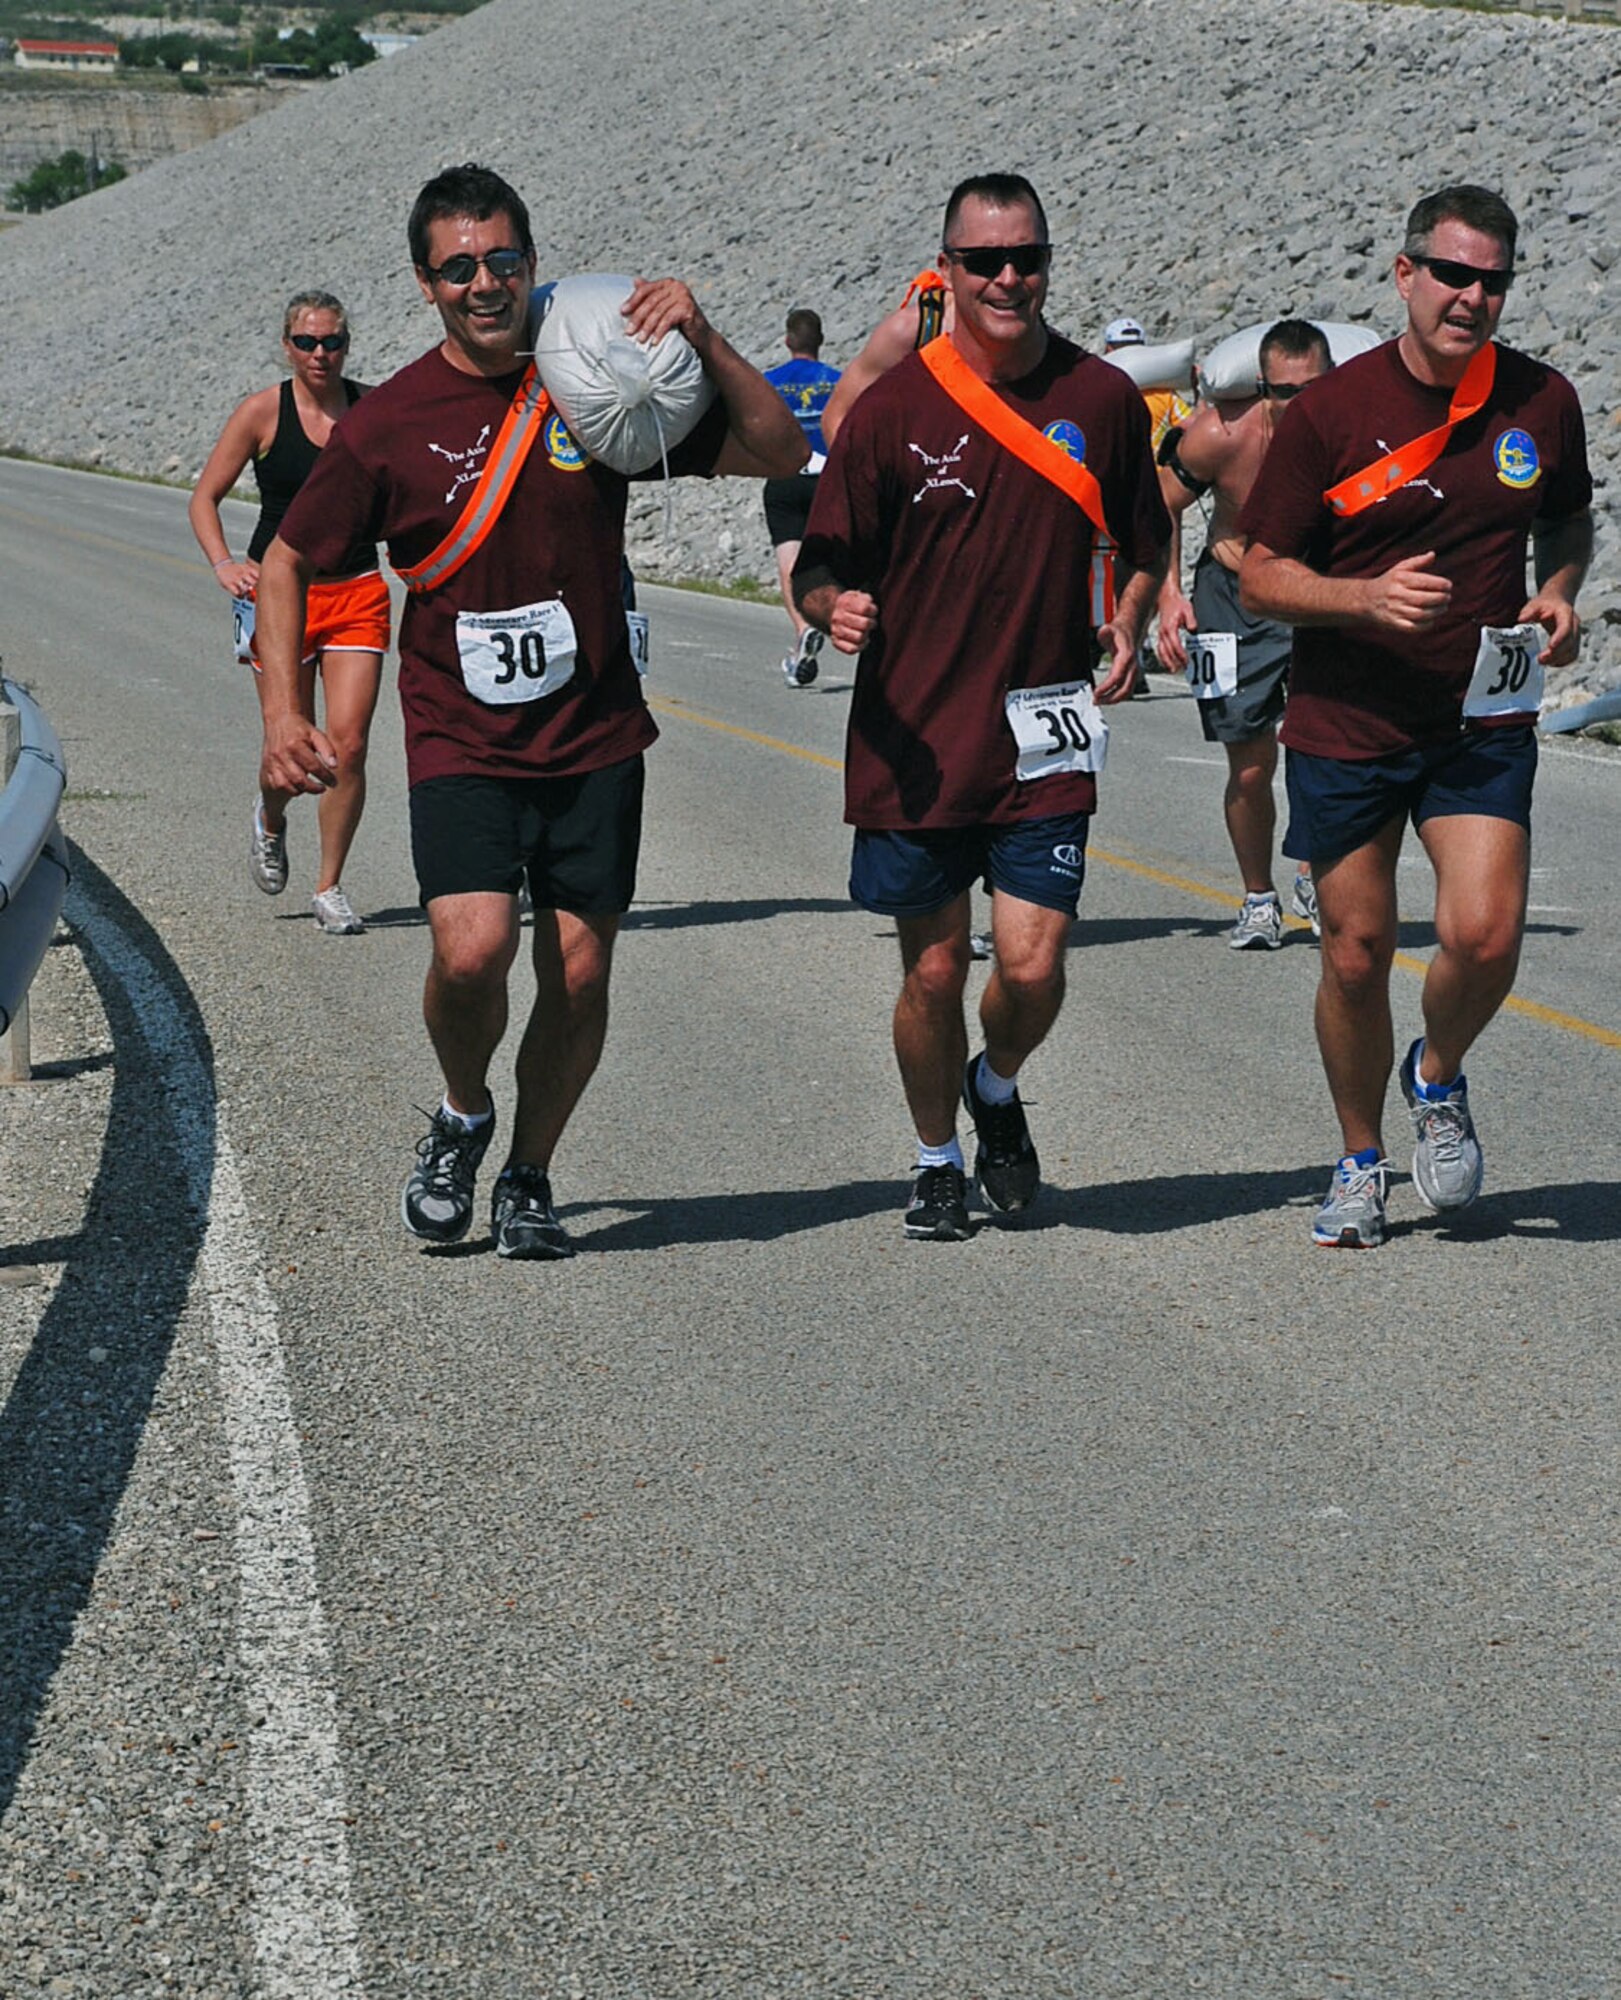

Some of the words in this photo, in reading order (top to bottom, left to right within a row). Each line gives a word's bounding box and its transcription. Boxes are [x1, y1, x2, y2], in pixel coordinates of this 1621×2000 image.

[445, 453, 465, 463] The
[467, 446, 487, 457] Axis
[922, 455, 940, 466] The
[941, 454, 962, 464] Axis
[464, 459, 475, 469] of
[937, 465, 948, 475] of
[529, 608, 551, 619] Race
[490, 631, 547, 685] 30
[1191, 650, 1216, 686] 10
[1486, 645, 1531, 695] 30
[1034, 707, 1091, 756] 30
